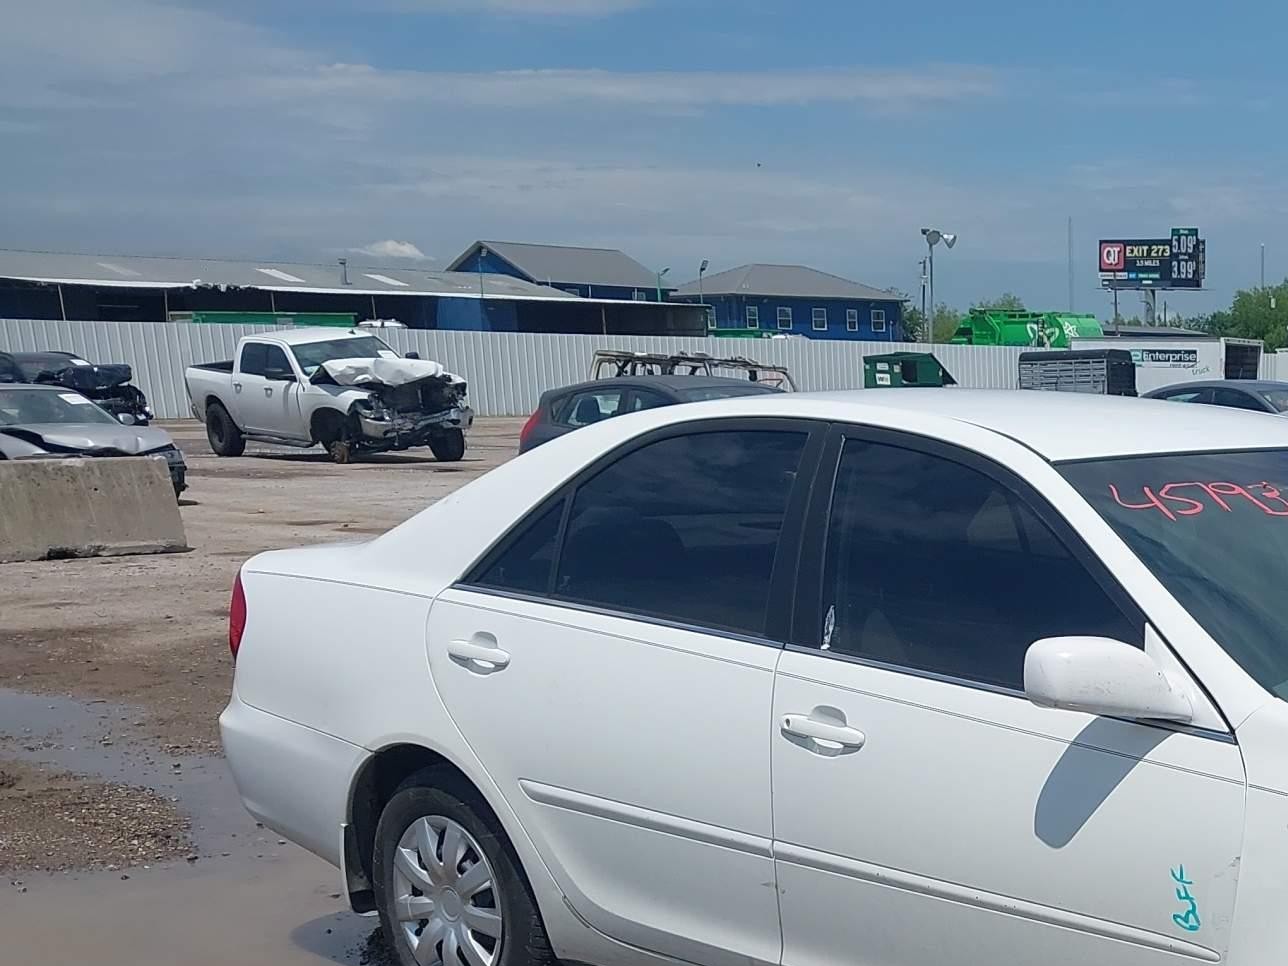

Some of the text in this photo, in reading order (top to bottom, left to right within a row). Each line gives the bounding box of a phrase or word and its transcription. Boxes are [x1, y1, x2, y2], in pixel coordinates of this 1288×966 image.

[1103, 247, 1120, 264] QT
[1126, 245, 1170, 256] EXIT 273
[1143, 351, 1196, 363] Enterprise
